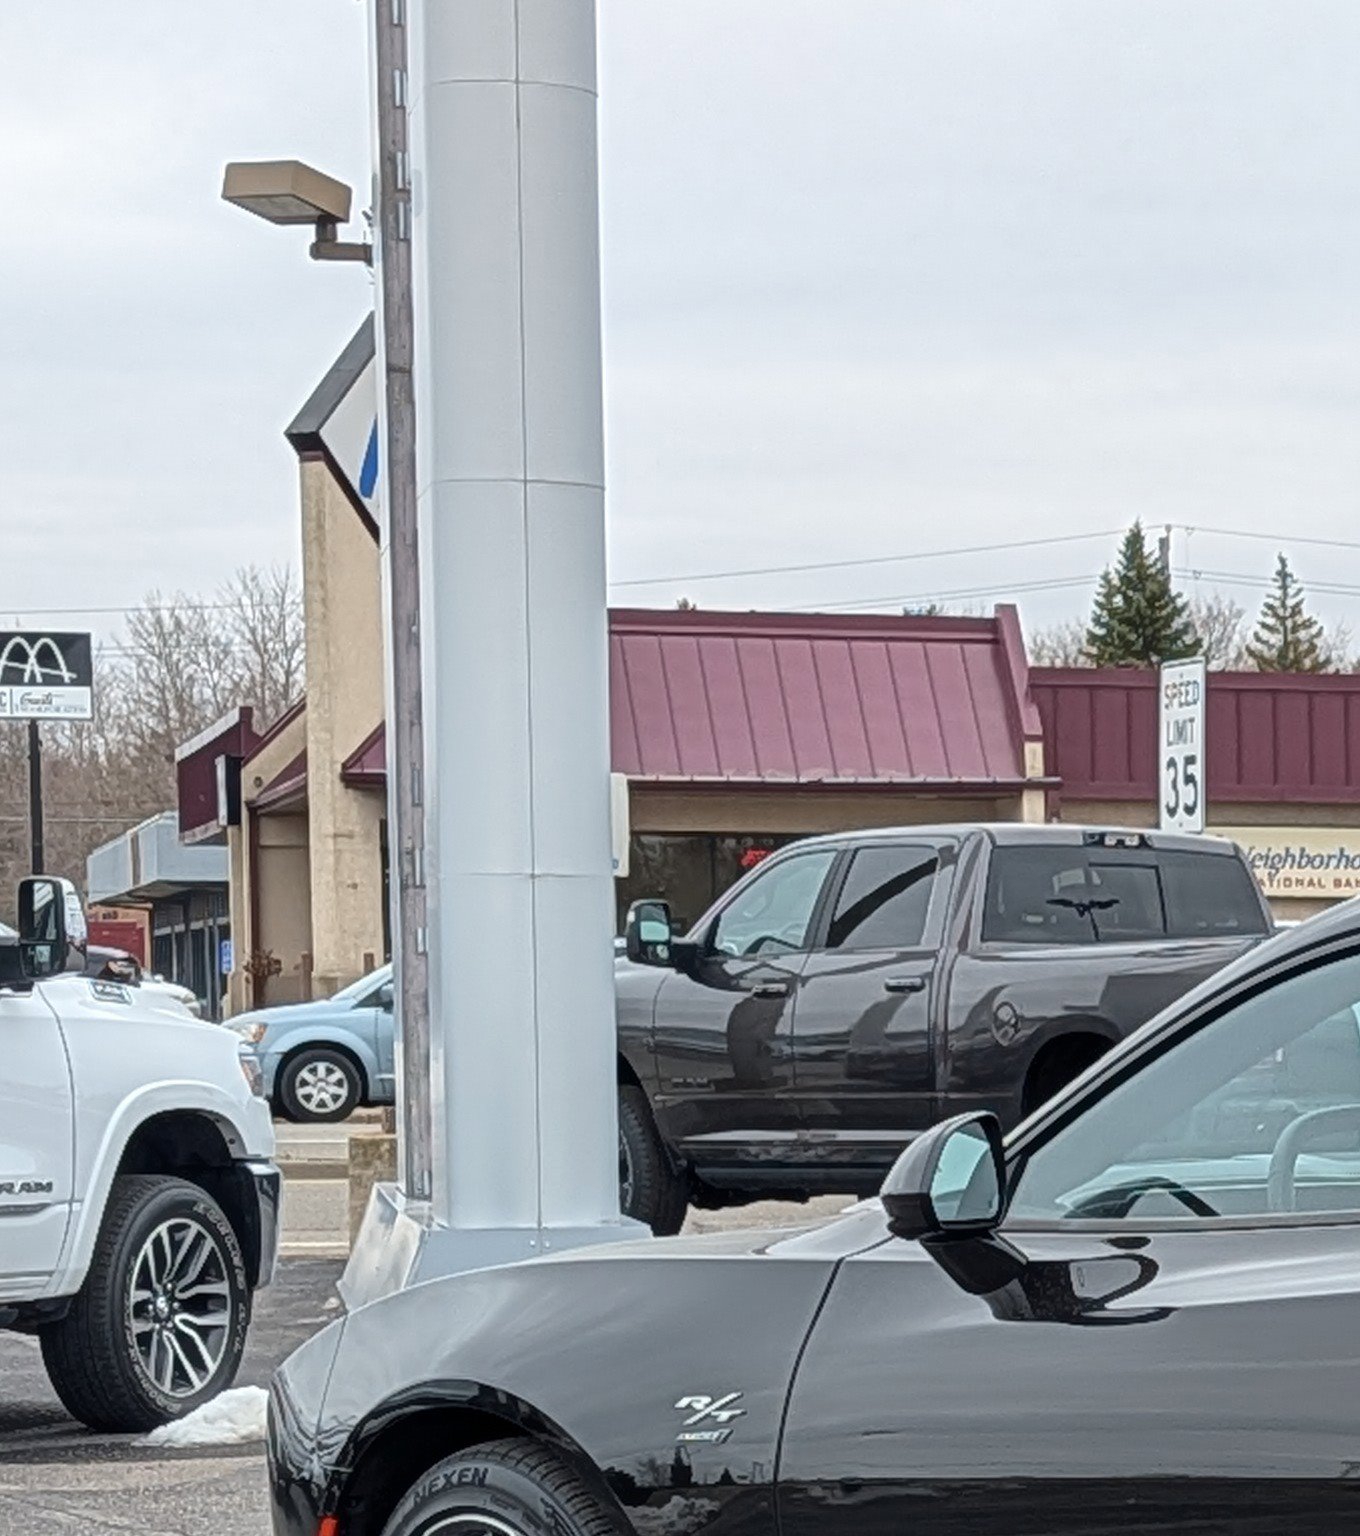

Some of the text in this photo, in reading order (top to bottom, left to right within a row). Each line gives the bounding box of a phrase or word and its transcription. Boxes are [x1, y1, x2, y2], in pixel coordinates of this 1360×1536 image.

[1165, 680, 1200, 710] SPEED
[1166, 716, 1196, 747] LIMIT
[1165, 754, 1199, 819] 35
[1256, 876, 1327, 890] ATIONAL
[674, 1391, 747, 1426] R/T
[412, 1466, 489, 1507] NEXEN
